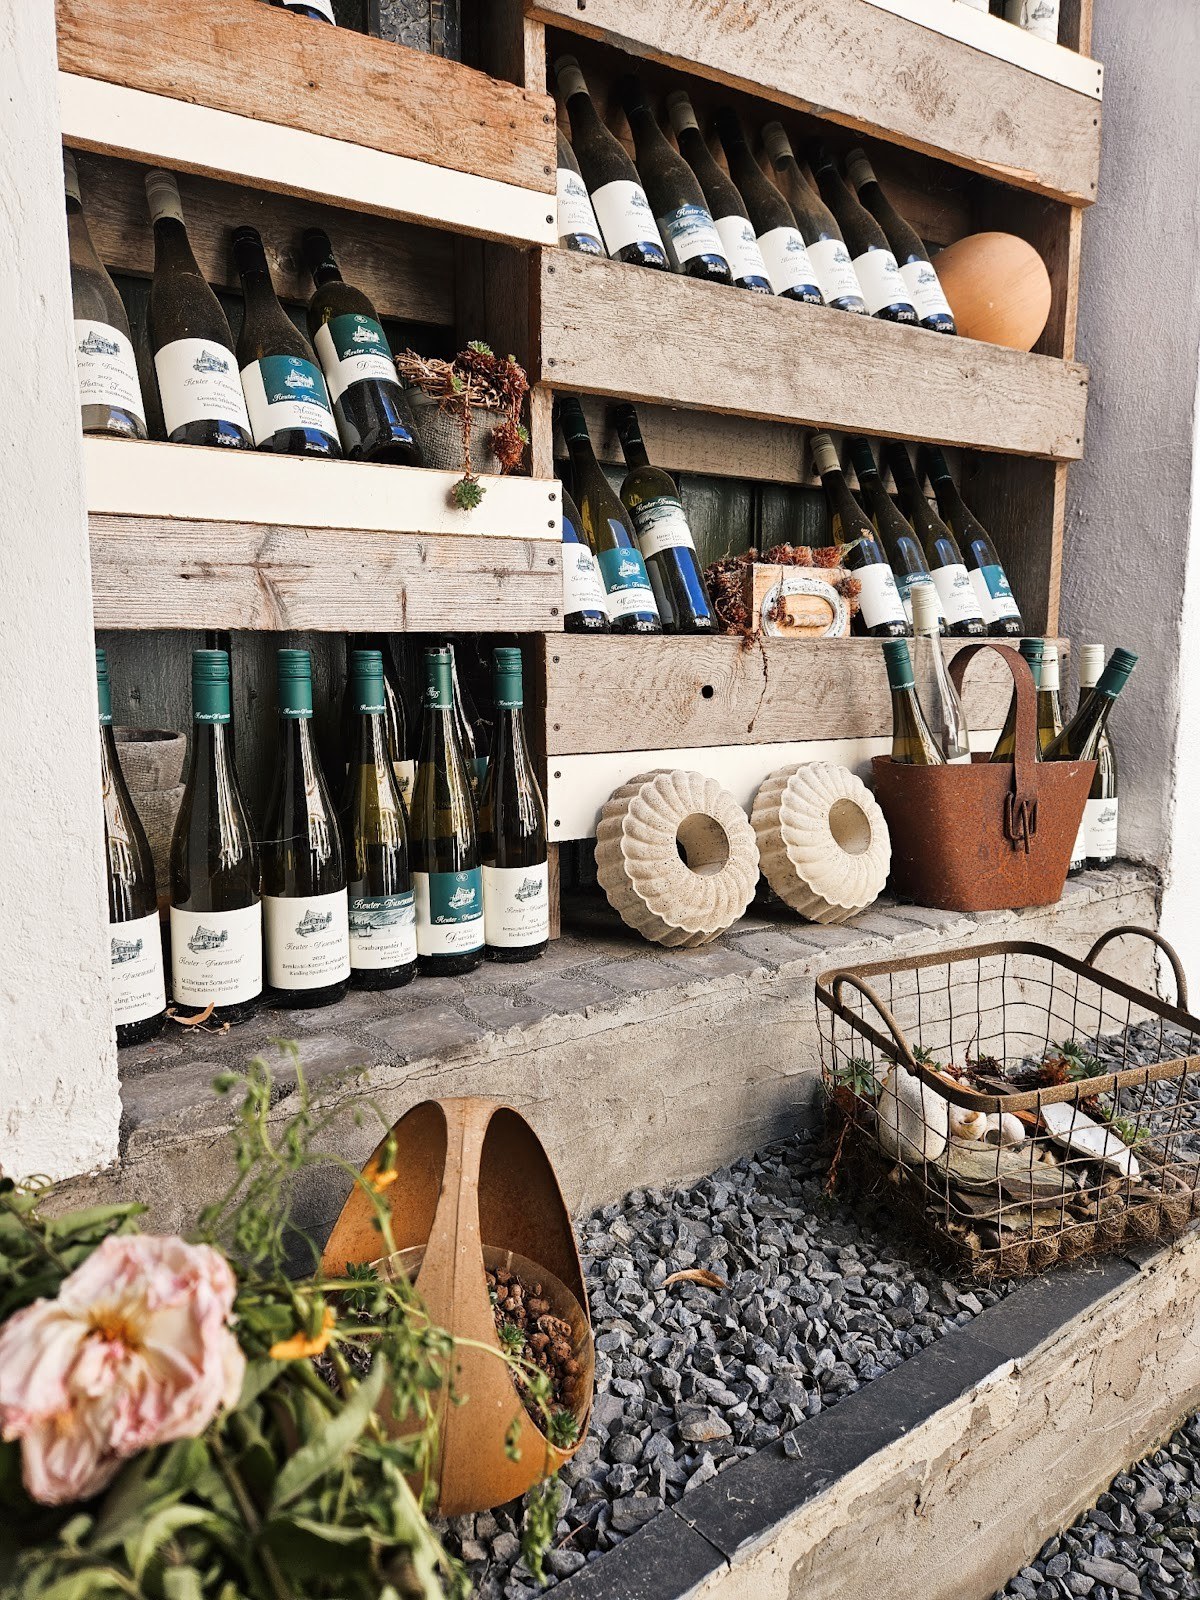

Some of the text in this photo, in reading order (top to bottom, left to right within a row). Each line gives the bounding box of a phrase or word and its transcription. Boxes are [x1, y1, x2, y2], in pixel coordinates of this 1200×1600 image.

[184, 378, 208, 386] Reuter
[272, 393, 296, 402] Reuter
[435, 915, 457, 923] Reuter
[284, 942, 308, 950] Reuter
[178, 956, 199, 967] Reuter
